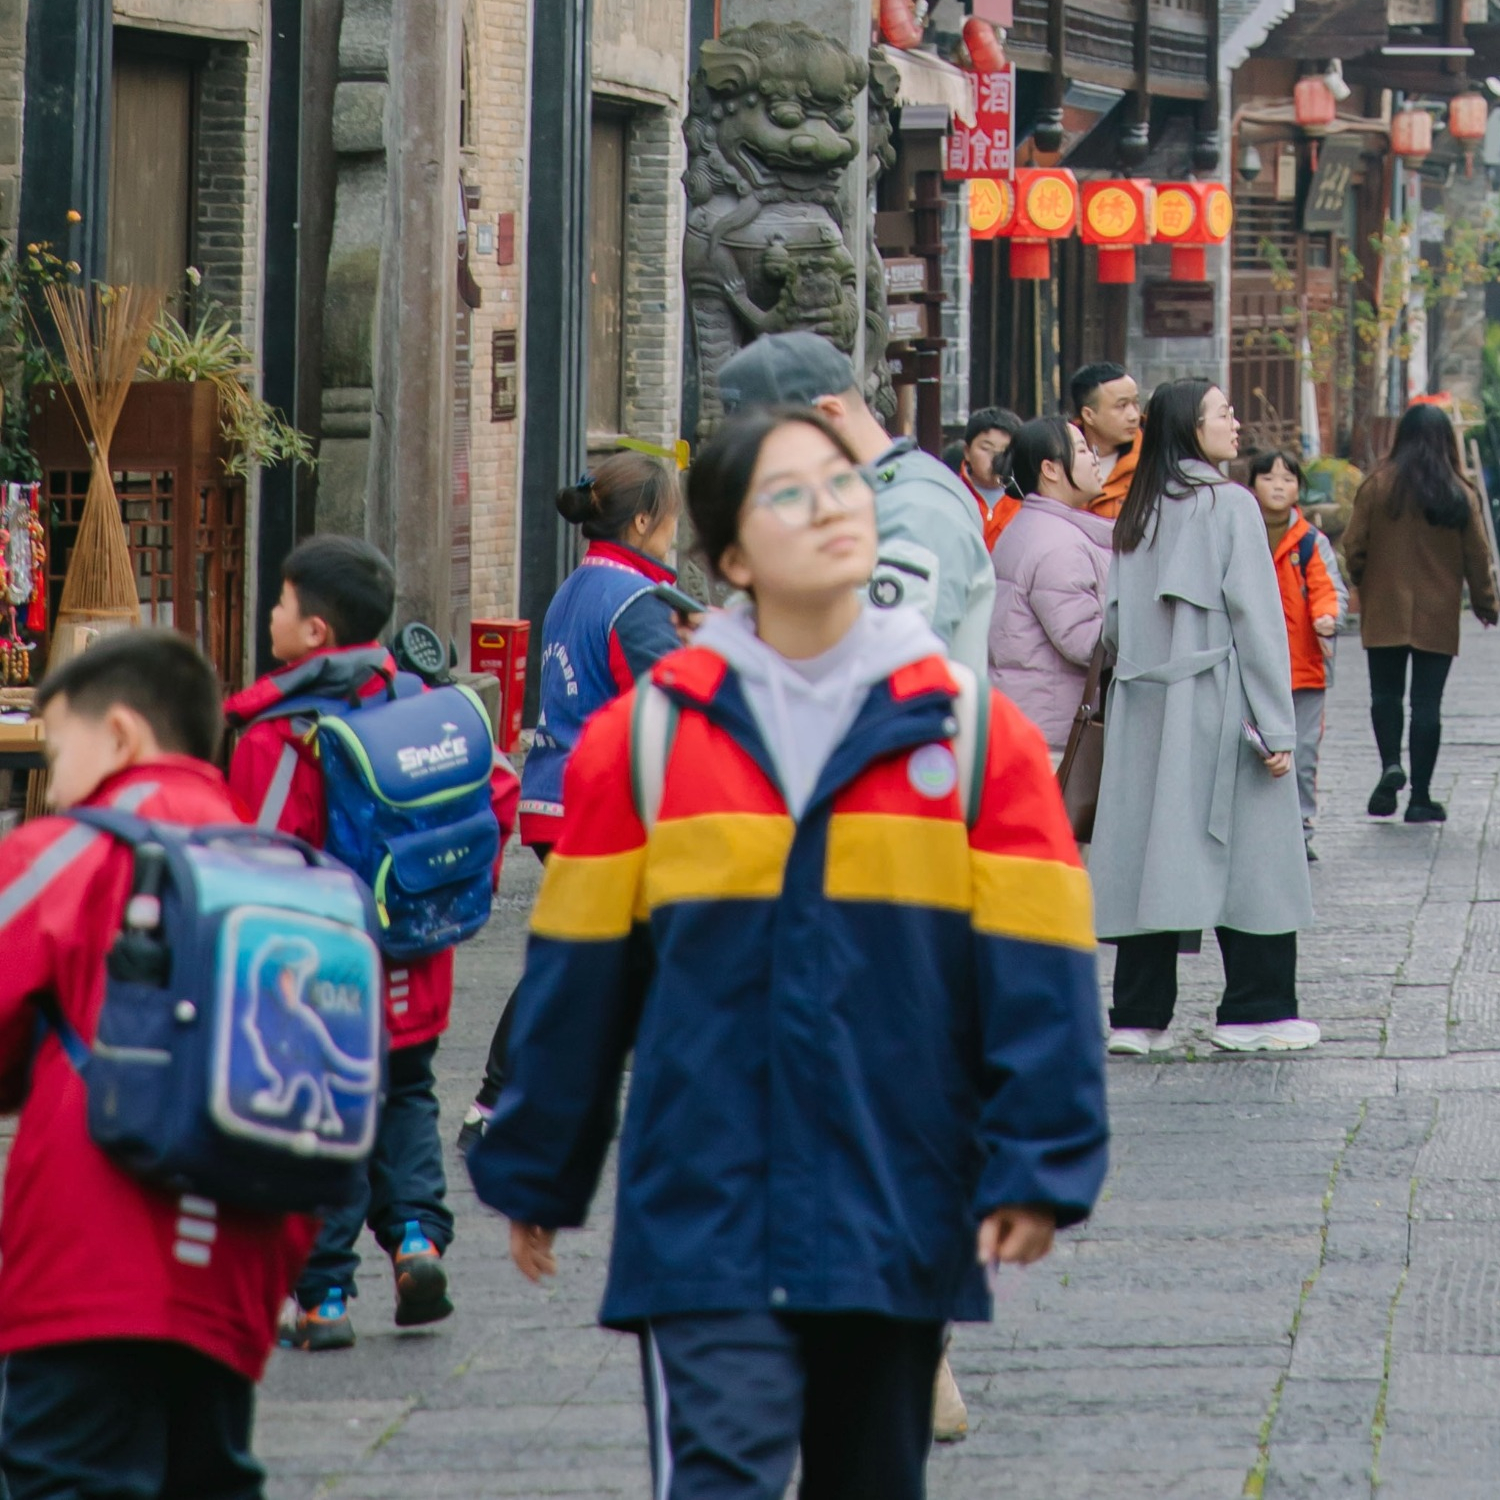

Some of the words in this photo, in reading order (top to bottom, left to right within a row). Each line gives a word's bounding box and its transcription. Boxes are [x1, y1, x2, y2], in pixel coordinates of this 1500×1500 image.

[1036, 187, 1066, 220] 桃
[1095, 193, 1128, 230] 绣
[397, 736, 468, 773] SPACE
